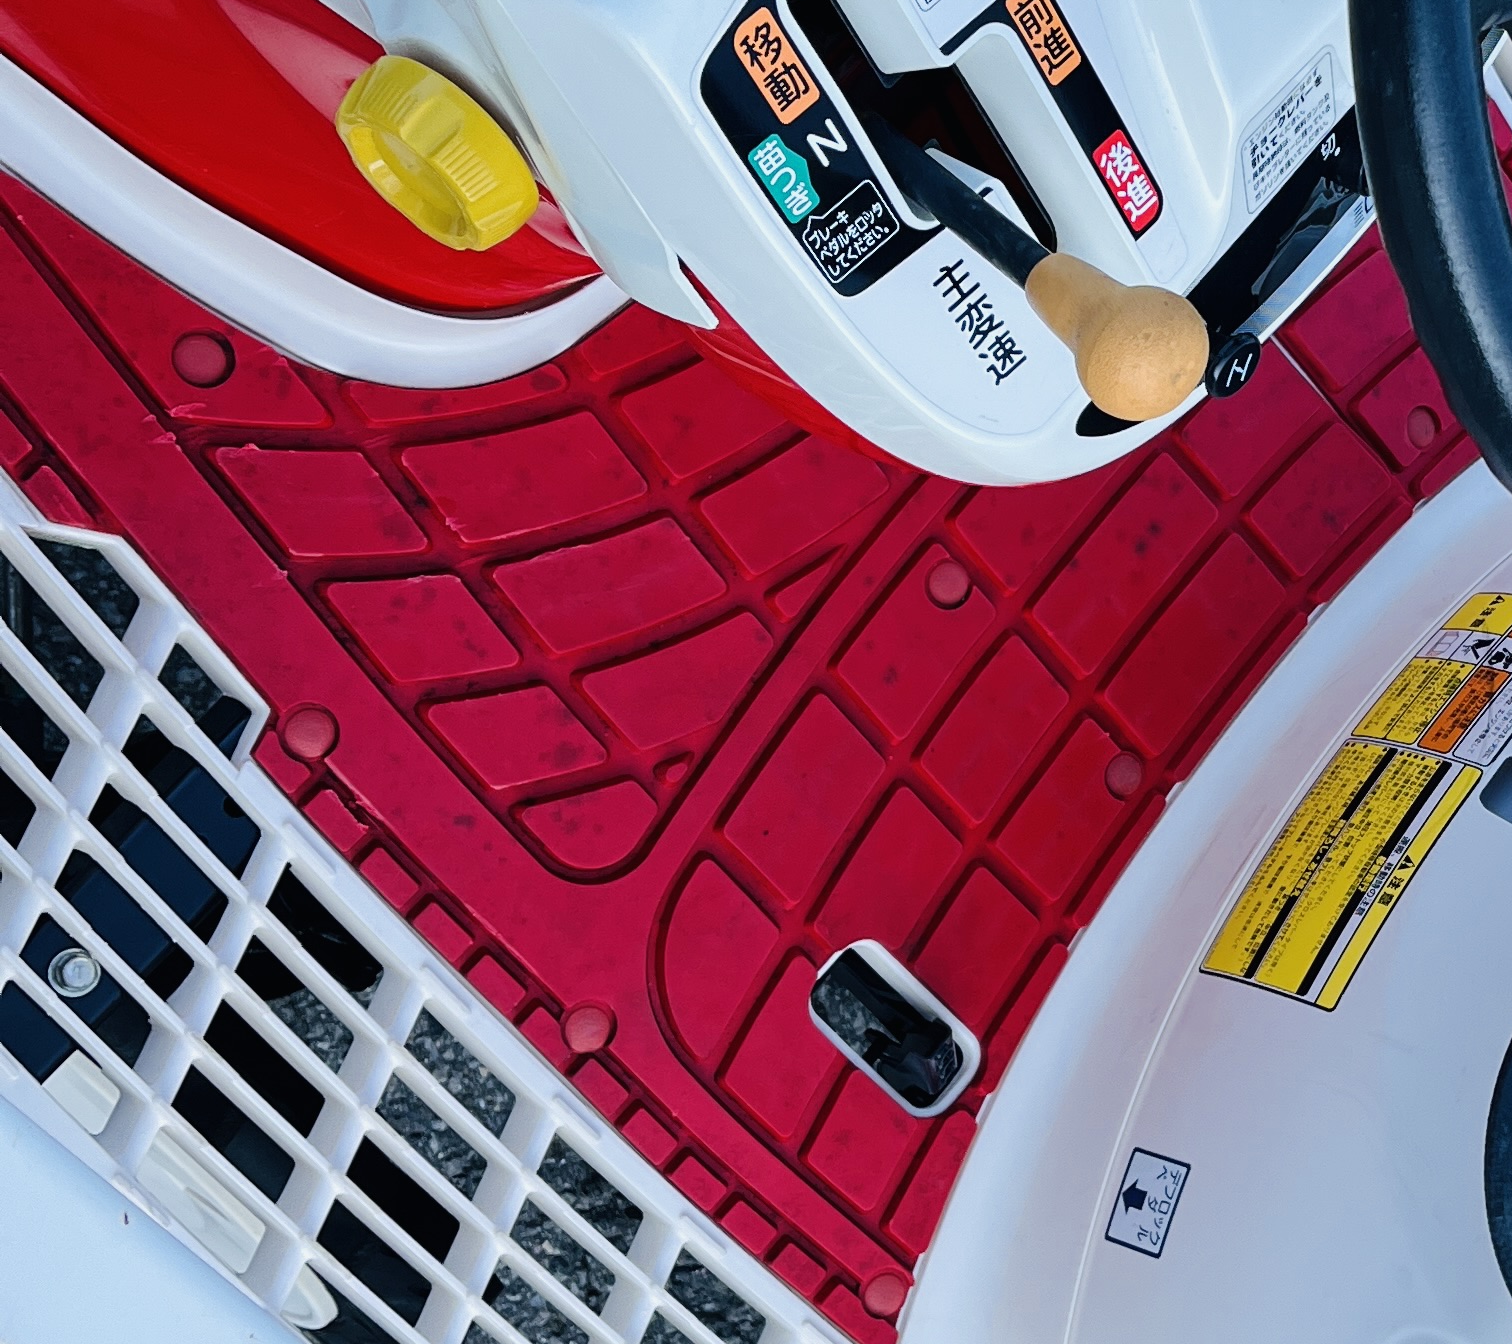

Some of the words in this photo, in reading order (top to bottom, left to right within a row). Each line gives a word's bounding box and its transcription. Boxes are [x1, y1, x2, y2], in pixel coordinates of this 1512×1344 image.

[741, 23, 810, 113] 移動
[753, 139, 815, 220] 苗つぎ
[806, 118, 848, 168] N
[1320, 132, 1336, 162] 切
[1099, 144, 1158, 224] 後進
[808, 210, 850, 249] ブレーキ
[827, 225, 890, 277] してください。
[932, 256, 1026, 386] 主変速
[1376, 875, 1405, 906] 注意
[1136, 1165, 1168, 1242] ペダル
[1149, 1169, 1182, 1246] デフロック
